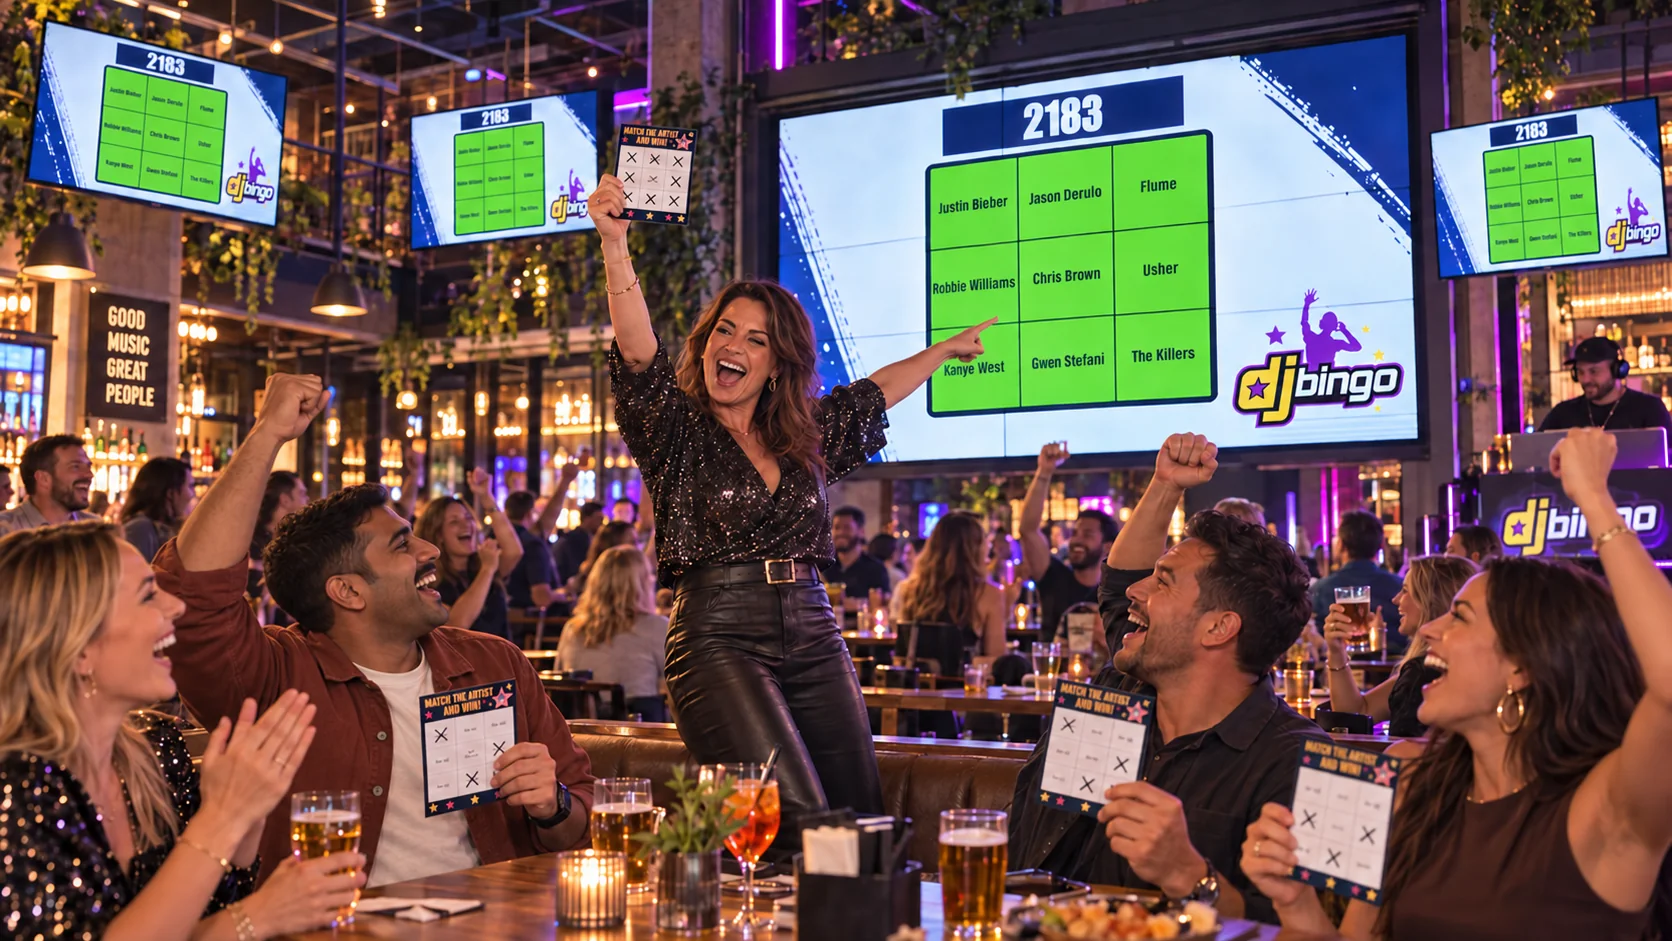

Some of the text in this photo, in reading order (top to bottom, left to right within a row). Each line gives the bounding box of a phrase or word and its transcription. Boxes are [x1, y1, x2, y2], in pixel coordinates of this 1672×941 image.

[146, 52, 185, 76] 2183
[481, 108, 510, 126] 2183
[1022, 94, 1103, 141] 2183
[1515, 121, 1548, 141] 2183
[1140, 178, 1177, 193] Flume
[938, 195, 1008, 214] Justin Bieber
[1028, 185, 1102, 206] Jason Derulo
[1033, 268, 1101, 285] Chris Brown
[1143, 262, 1179, 277] Usher
[932, 276, 1016, 295] Robbie Williams
[107, 305, 146, 331] GOOD
[107, 331, 150, 356] MUSIC
[1031, 352, 1105, 370] Gwen Stefani
[1131, 346, 1195, 363] The Killers
[106, 357, 149, 381] GREAT
[943, 360, 1005, 377] Kanye West
[105, 382, 155, 407] PEOPLE
[424, 686, 494, 709] MATCH THE ARTIST
[1060, 683, 1087, 696] MATCH
[443, 704, 460, 717] AND
[1075, 698, 1092, 710] AND
